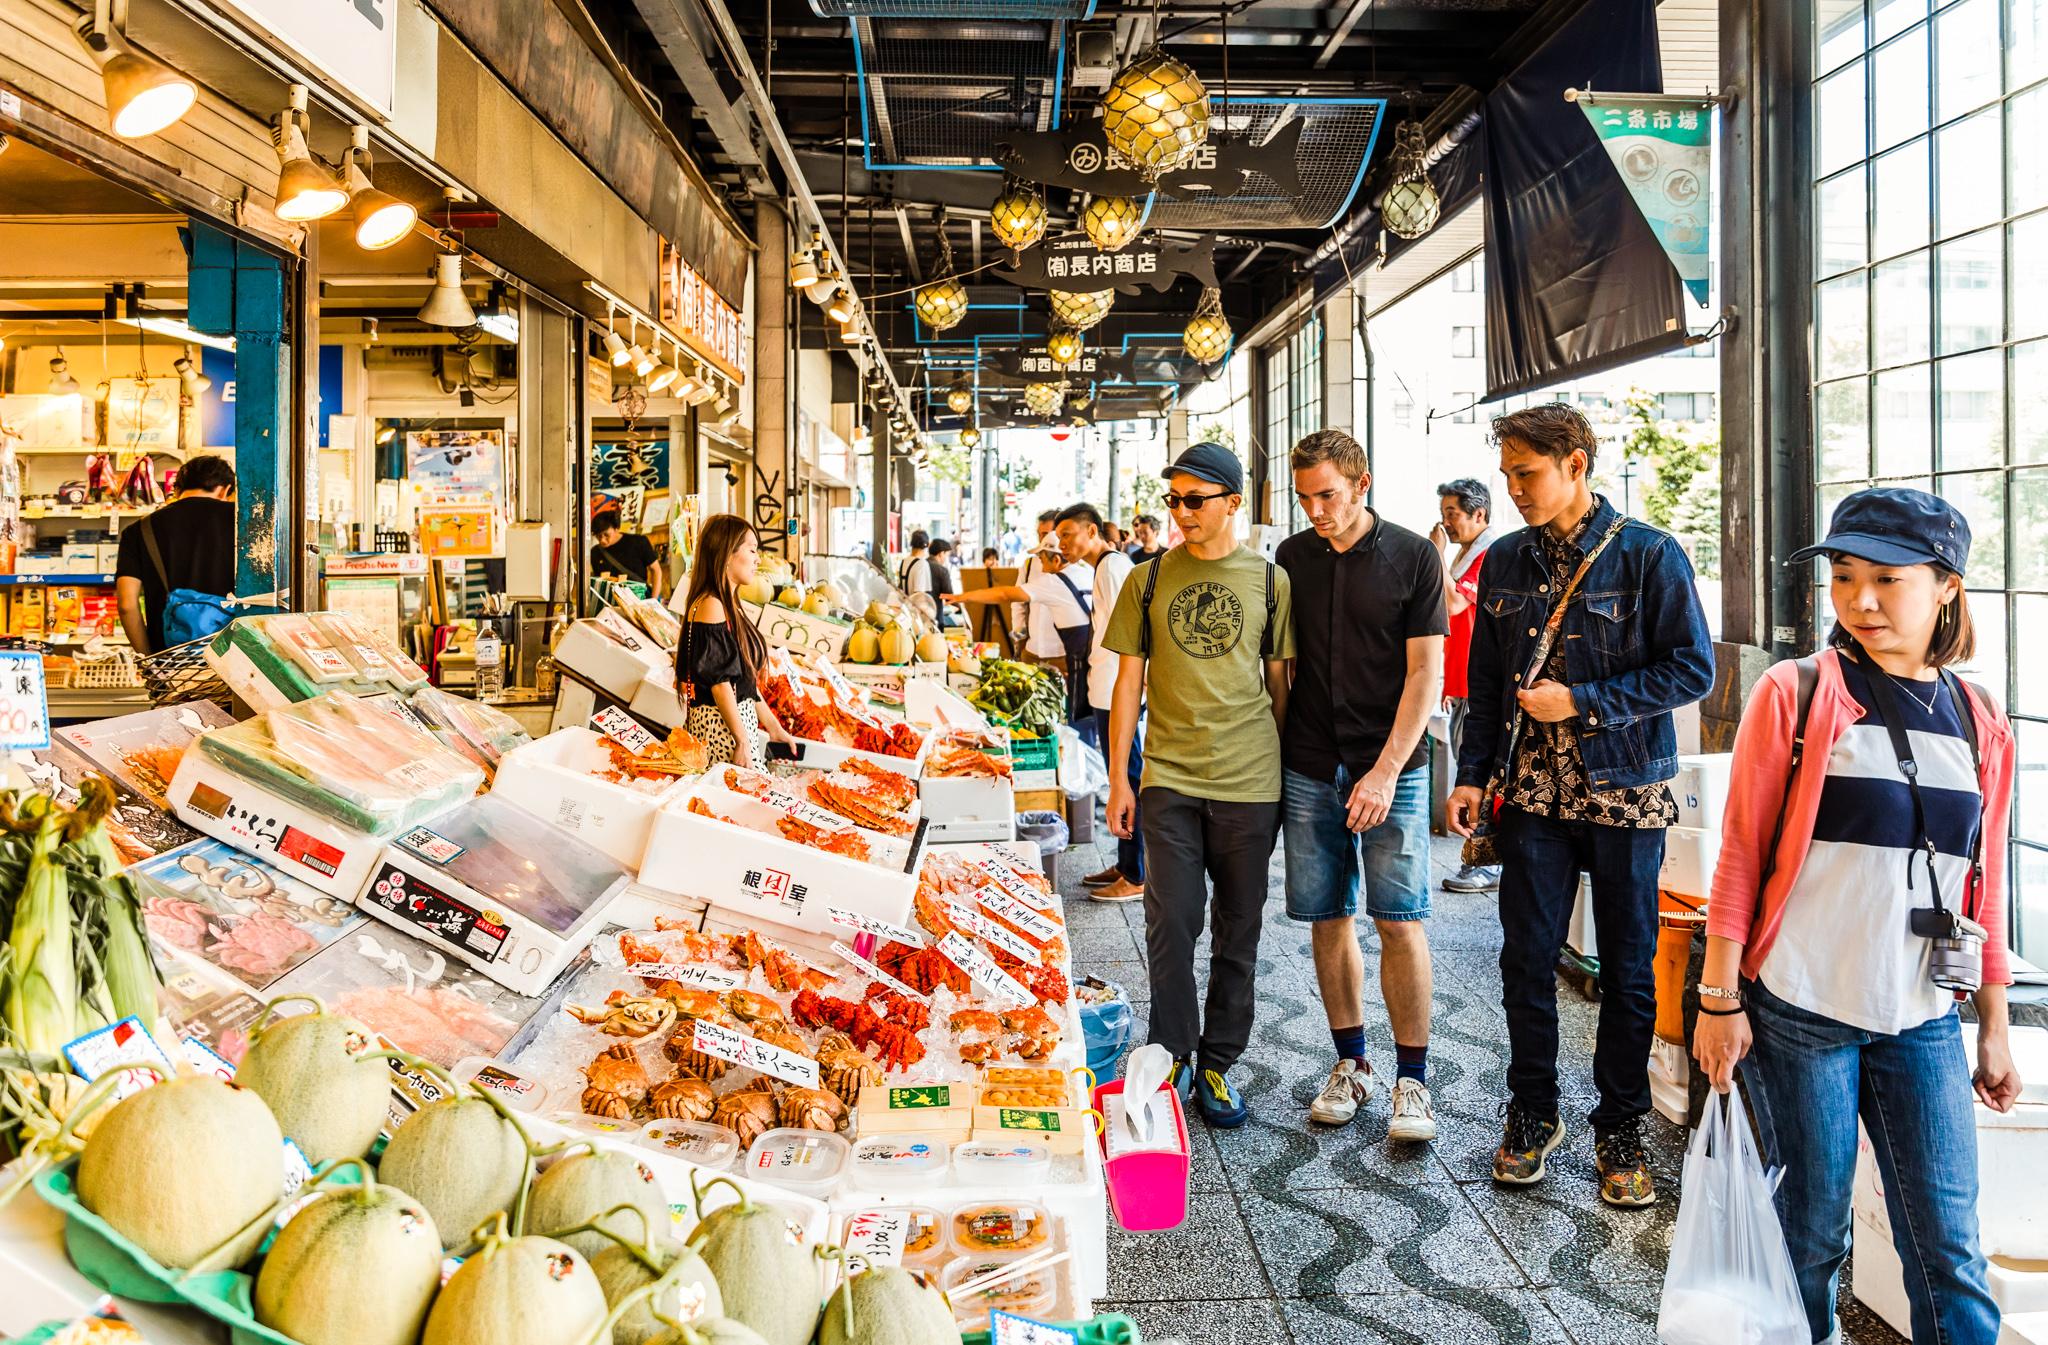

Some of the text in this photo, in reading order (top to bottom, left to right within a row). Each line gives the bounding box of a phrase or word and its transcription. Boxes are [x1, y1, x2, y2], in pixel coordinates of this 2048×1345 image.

[1602, 109, 1698, 130] 二条市場
[1172, 584, 1242, 631] YOU CAN'T EAT MONEY
[1202, 642, 1225, 654] 1973
[742, 869, 763, 890] 根
[788, 883, 809, 903] 室
